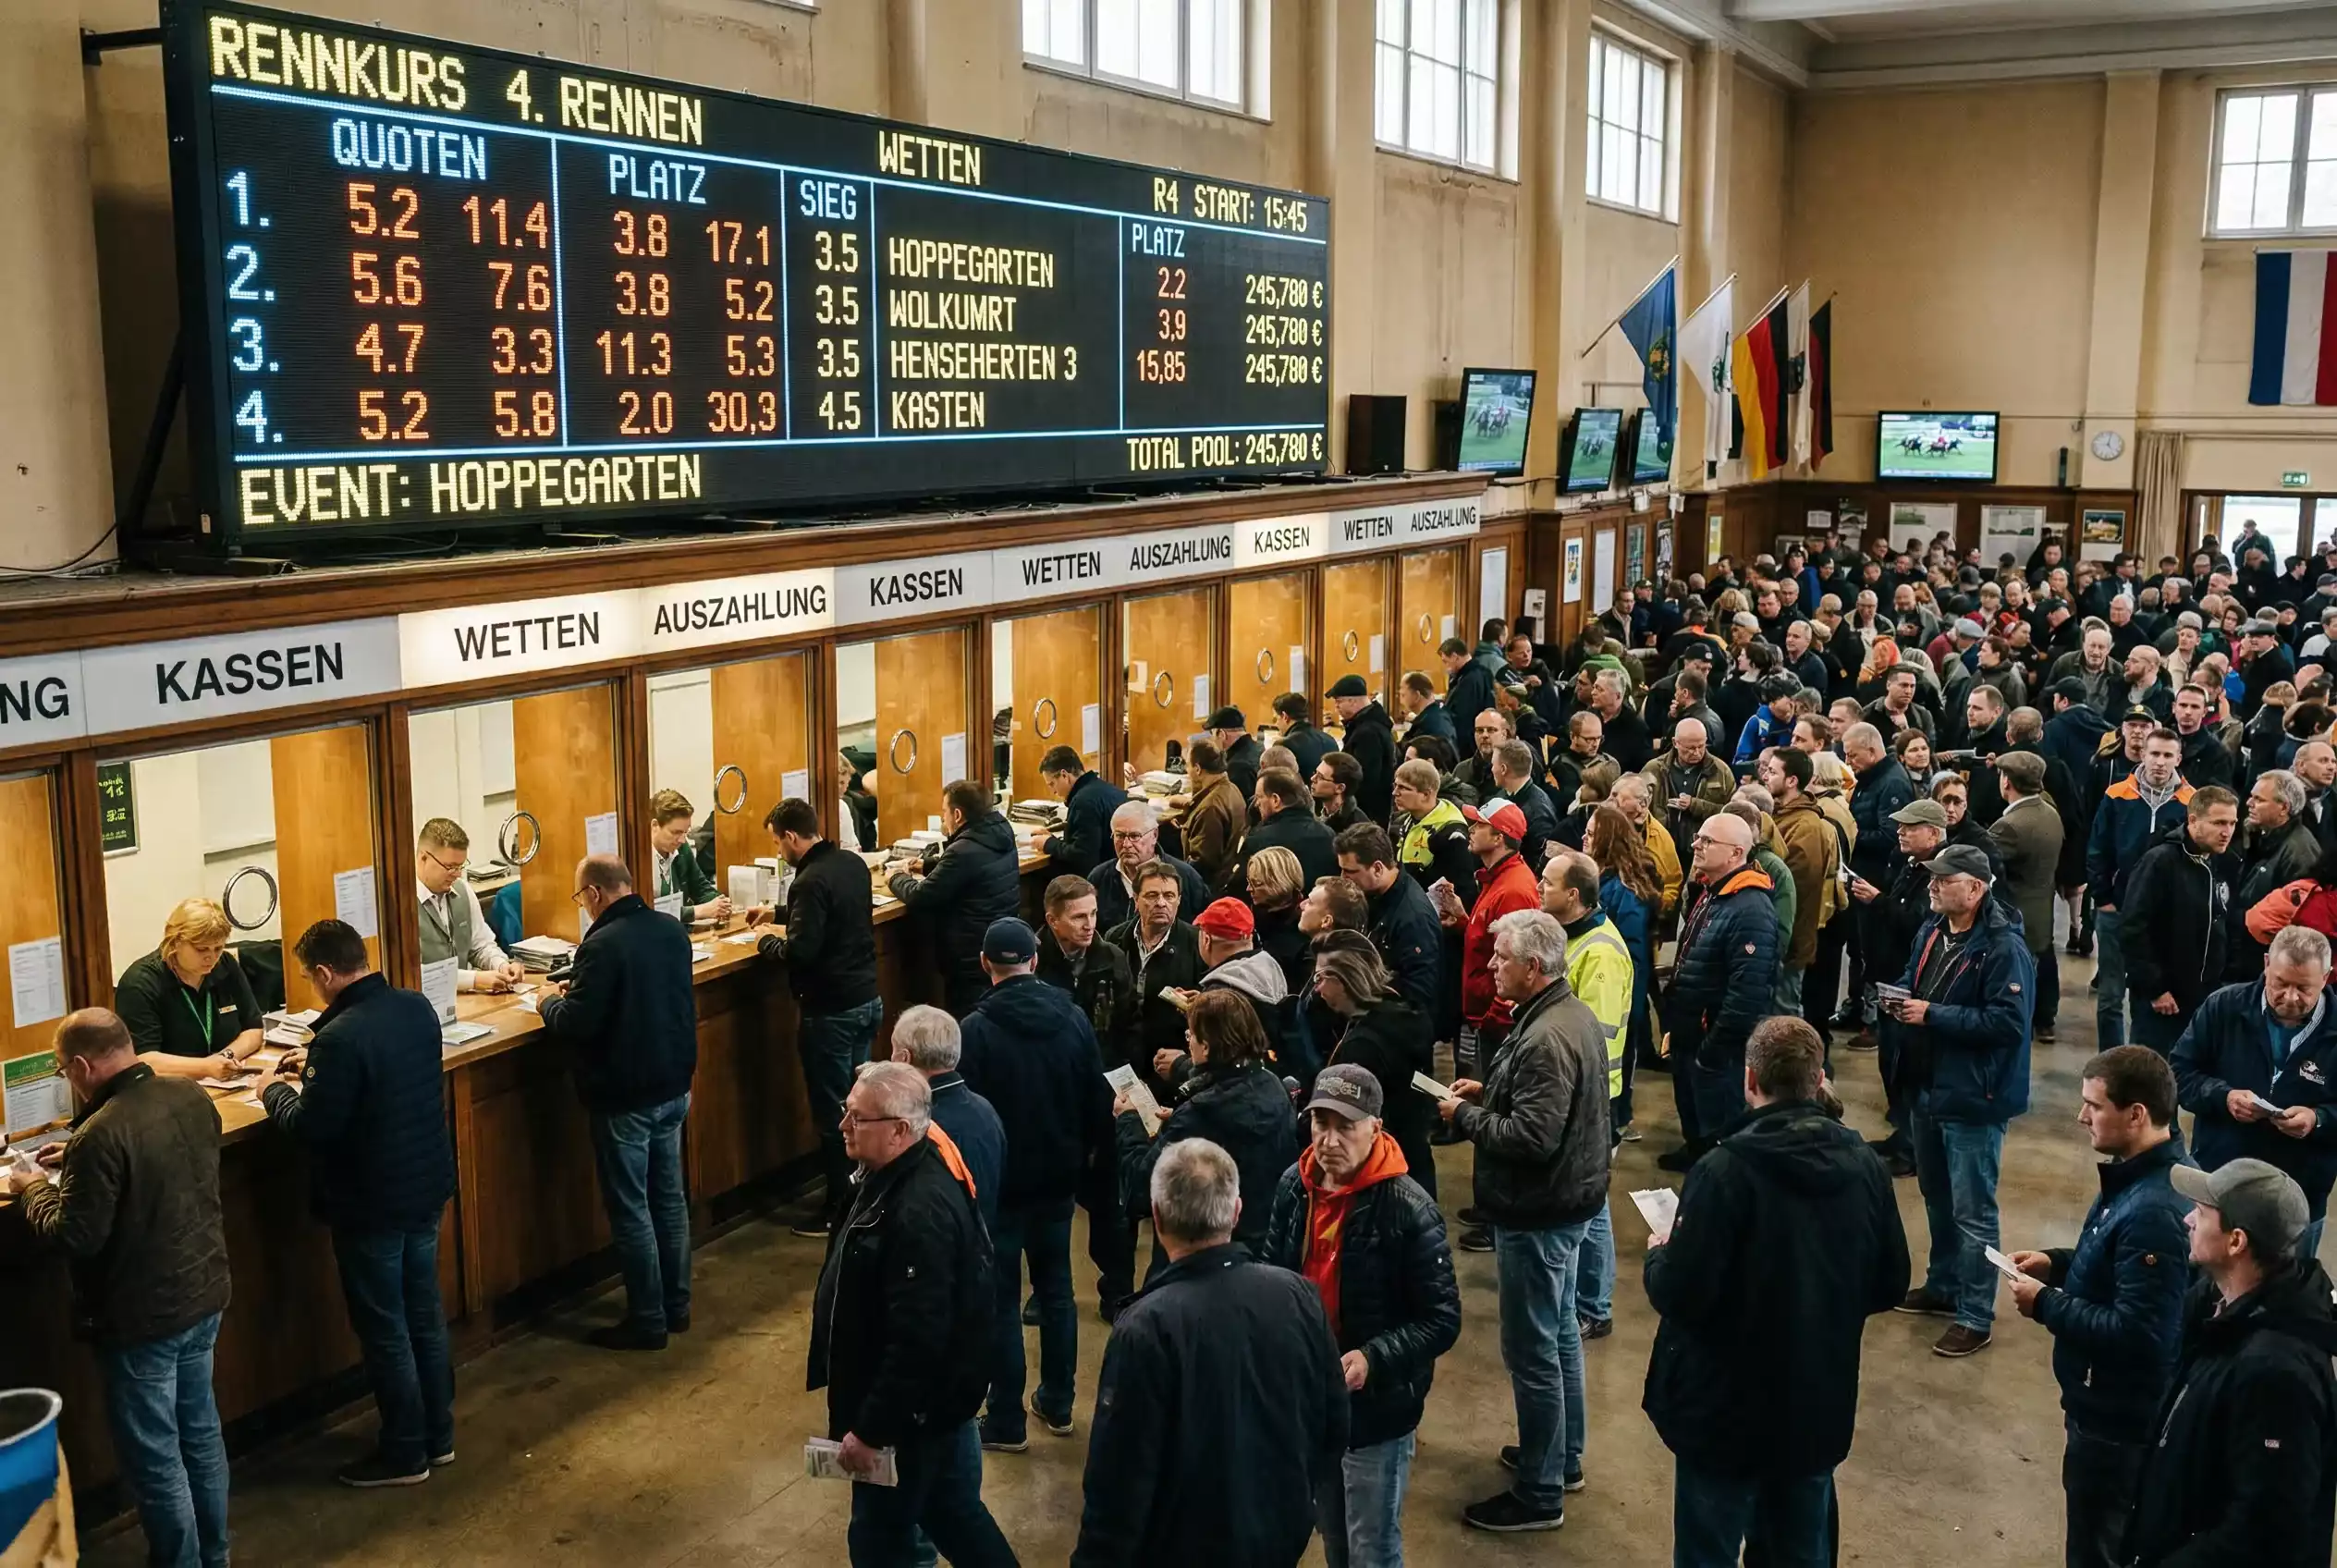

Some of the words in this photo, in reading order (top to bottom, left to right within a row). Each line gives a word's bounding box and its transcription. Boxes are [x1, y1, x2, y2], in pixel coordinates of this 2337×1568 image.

[210, 16, 466, 109] RENNKURS
[507, 70, 544, 122] 4.
[560, 77, 702, 144] RENNEN
[333, 118, 485, 179] QUOTEN
[880, 131, 980, 185] WETTEN
[609, 154, 705, 203] PLATZ
[801, 179, 856, 220] SIEG
[1155, 178, 1178, 214] R4
[1194, 185, 1254, 224] START:
[1265, 196, 1307, 232] 15:45
[227, 172, 269, 227] 1.
[349, 183, 419, 239] 5.2
[463, 196, 547, 248] 11.4
[614, 211, 667, 256] 3.8
[706, 221, 768, 265] 17.1
[815, 231, 858, 272] 3.5
[889, 238, 1053, 288] HOPPEGARTEN
[1159, 267, 1185, 299] 2.2
[1246, 275, 1307, 309] 245,780
[1312, 281, 1323, 308] €
[1132, 223, 1184, 257] PLATZ
[226, 245, 274, 300] 2.
[353, 252, 422, 305] 5.6
[489, 263, 550, 311] 7.6
[616, 272, 669, 315] 3.8
[727, 278, 773, 321] 5.2
[816, 285, 859, 325] 3.5
[890, 289, 1016, 331] WOLKUMRT
[1246, 314, 1307, 348] 245,780
[1312, 320, 1322, 346] €
[231, 318, 278, 371] 3.
[356, 324, 423, 372] 4.7
[492, 327, 552, 374] 3.3
[597, 331, 670, 374] 11.3
[728, 336, 774, 375] 5.3
[817, 338, 859, 377] 3.5
[891, 341, 1055, 380] HENSEHERTEN
[1064, 347, 1076, 380] 3
[1137, 350, 1185, 384] 15,85
[1246, 354, 1307, 386] 245,780
[1312, 357, 1322, 383] €
[236, 390, 282, 443] 4.
[360, 391, 429, 440] 5.2
[495, 391, 555, 436] 5.8
[619, 392, 672, 434] 2.0
[819, 392, 860, 430] 4.5
[892, 392, 984, 429] KASTEN
[1127, 437, 1185, 471] TOTAL
[1193, 435, 1239, 467] POOL:
[1246, 433, 1307, 466] 245,780
[1312, 433, 1322, 460] €
[241, 464, 410, 524] EVENT:
[430, 455, 700, 512] HOPPEGARTEN
[1255, 528, 1309, 553] KASSEN
[1344, 517, 1392, 540] WETTEN
[1412, 507, 1475, 531] AUSZAHLUNG
[1022, 551, 1100, 585] WETTEN
[1131, 535, 1230, 570] AUSZAHLUNG
[655, 585, 826, 634] AUSZAHLUNG
[871, 568, 962, 606] KASSEN
[455, 612, 599, 661] WETTEN
[157, 643, 343, 704] KASSEN
